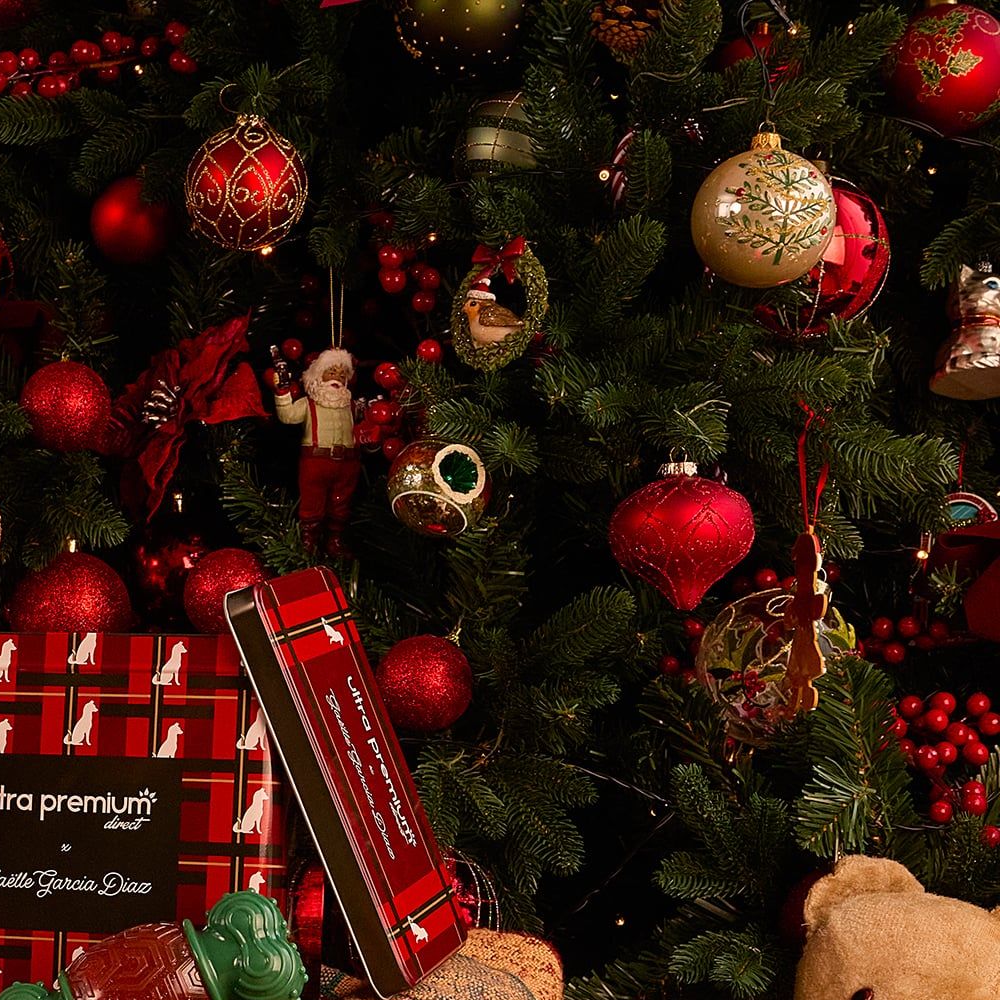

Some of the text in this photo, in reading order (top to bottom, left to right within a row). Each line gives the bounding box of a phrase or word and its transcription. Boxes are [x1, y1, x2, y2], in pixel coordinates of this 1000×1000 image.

[347, 675, 416, 846] ultra premium
[40, 792, 151, 821] premium
[103, 815, 151, 831] direct
[32, 869, 98, 898] Garcia
[97, 872, 152, 896] Diaz
